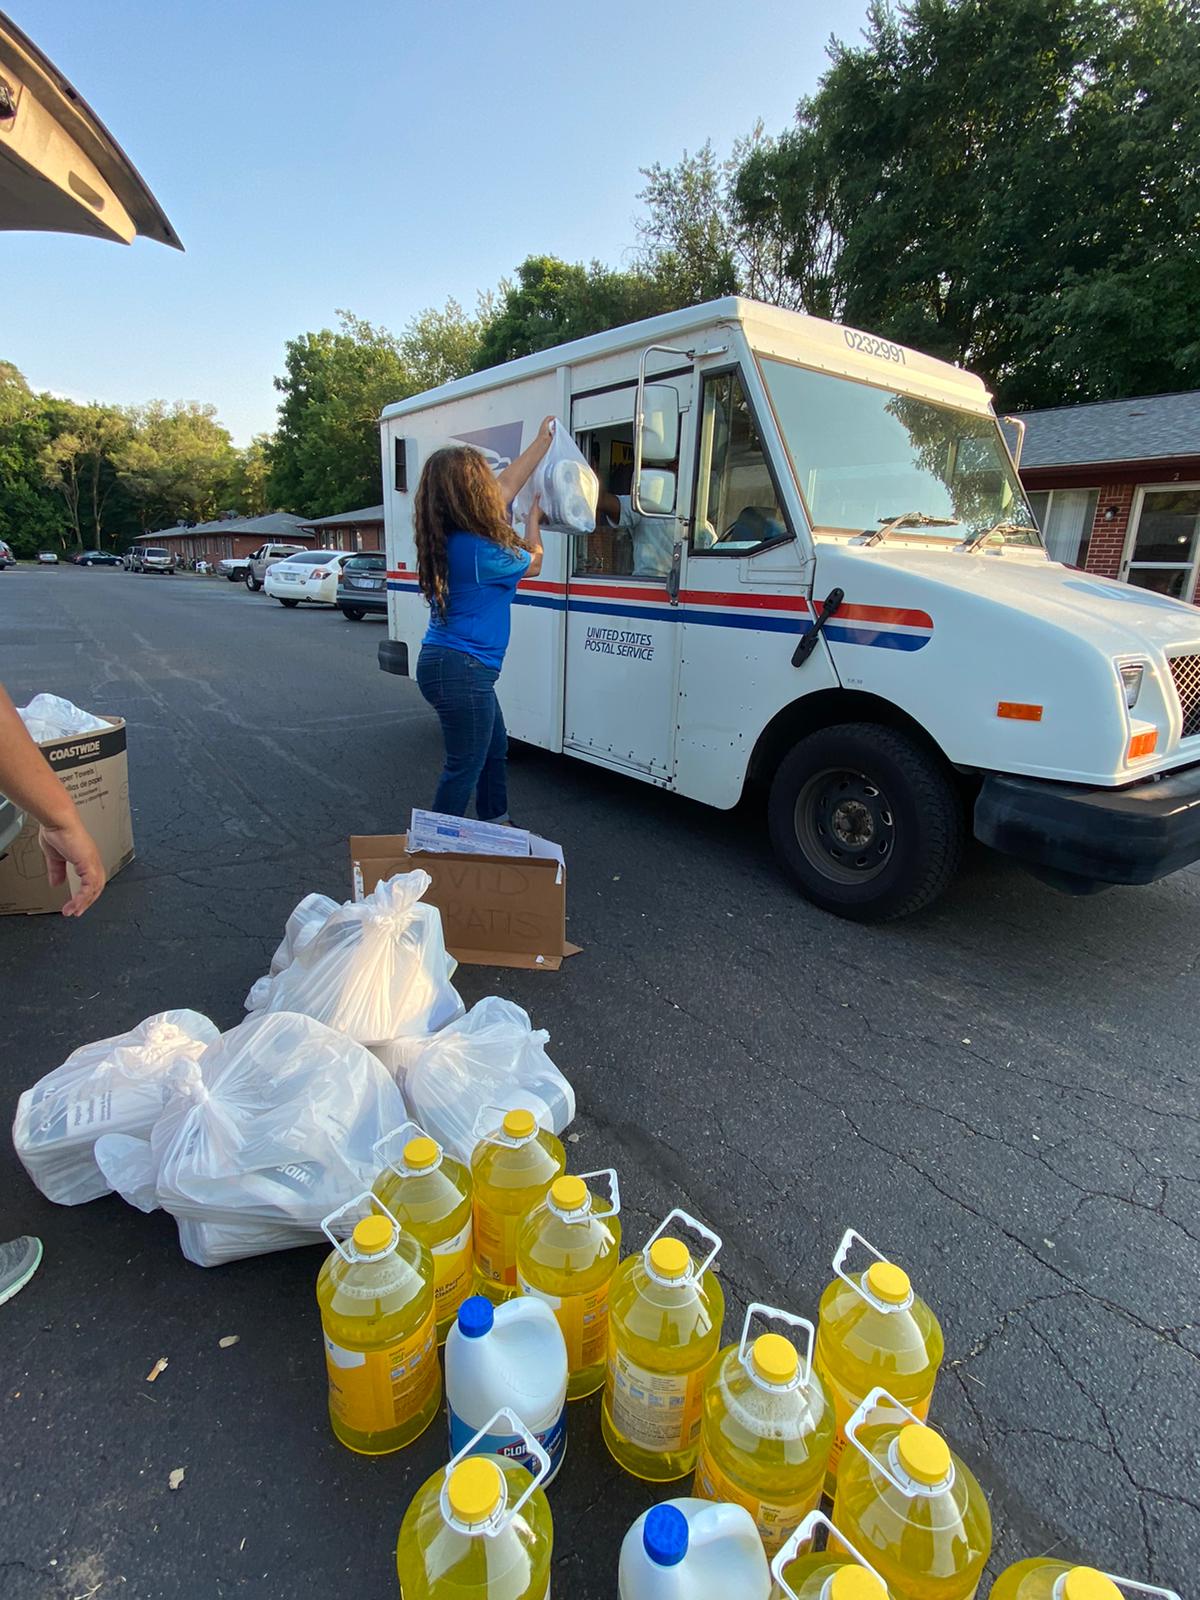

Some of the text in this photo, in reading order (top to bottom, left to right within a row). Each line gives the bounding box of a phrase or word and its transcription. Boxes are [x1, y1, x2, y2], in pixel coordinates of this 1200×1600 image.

[844, 330, 906, 365] 0232991
[587, 627, 652, 646] UNITED STATES
[584, 640, 655, 661] POSTAL SERVICE
[50, 741, 100, 761] COASTWIDE
[445, 903, 544, 939] RATIS
